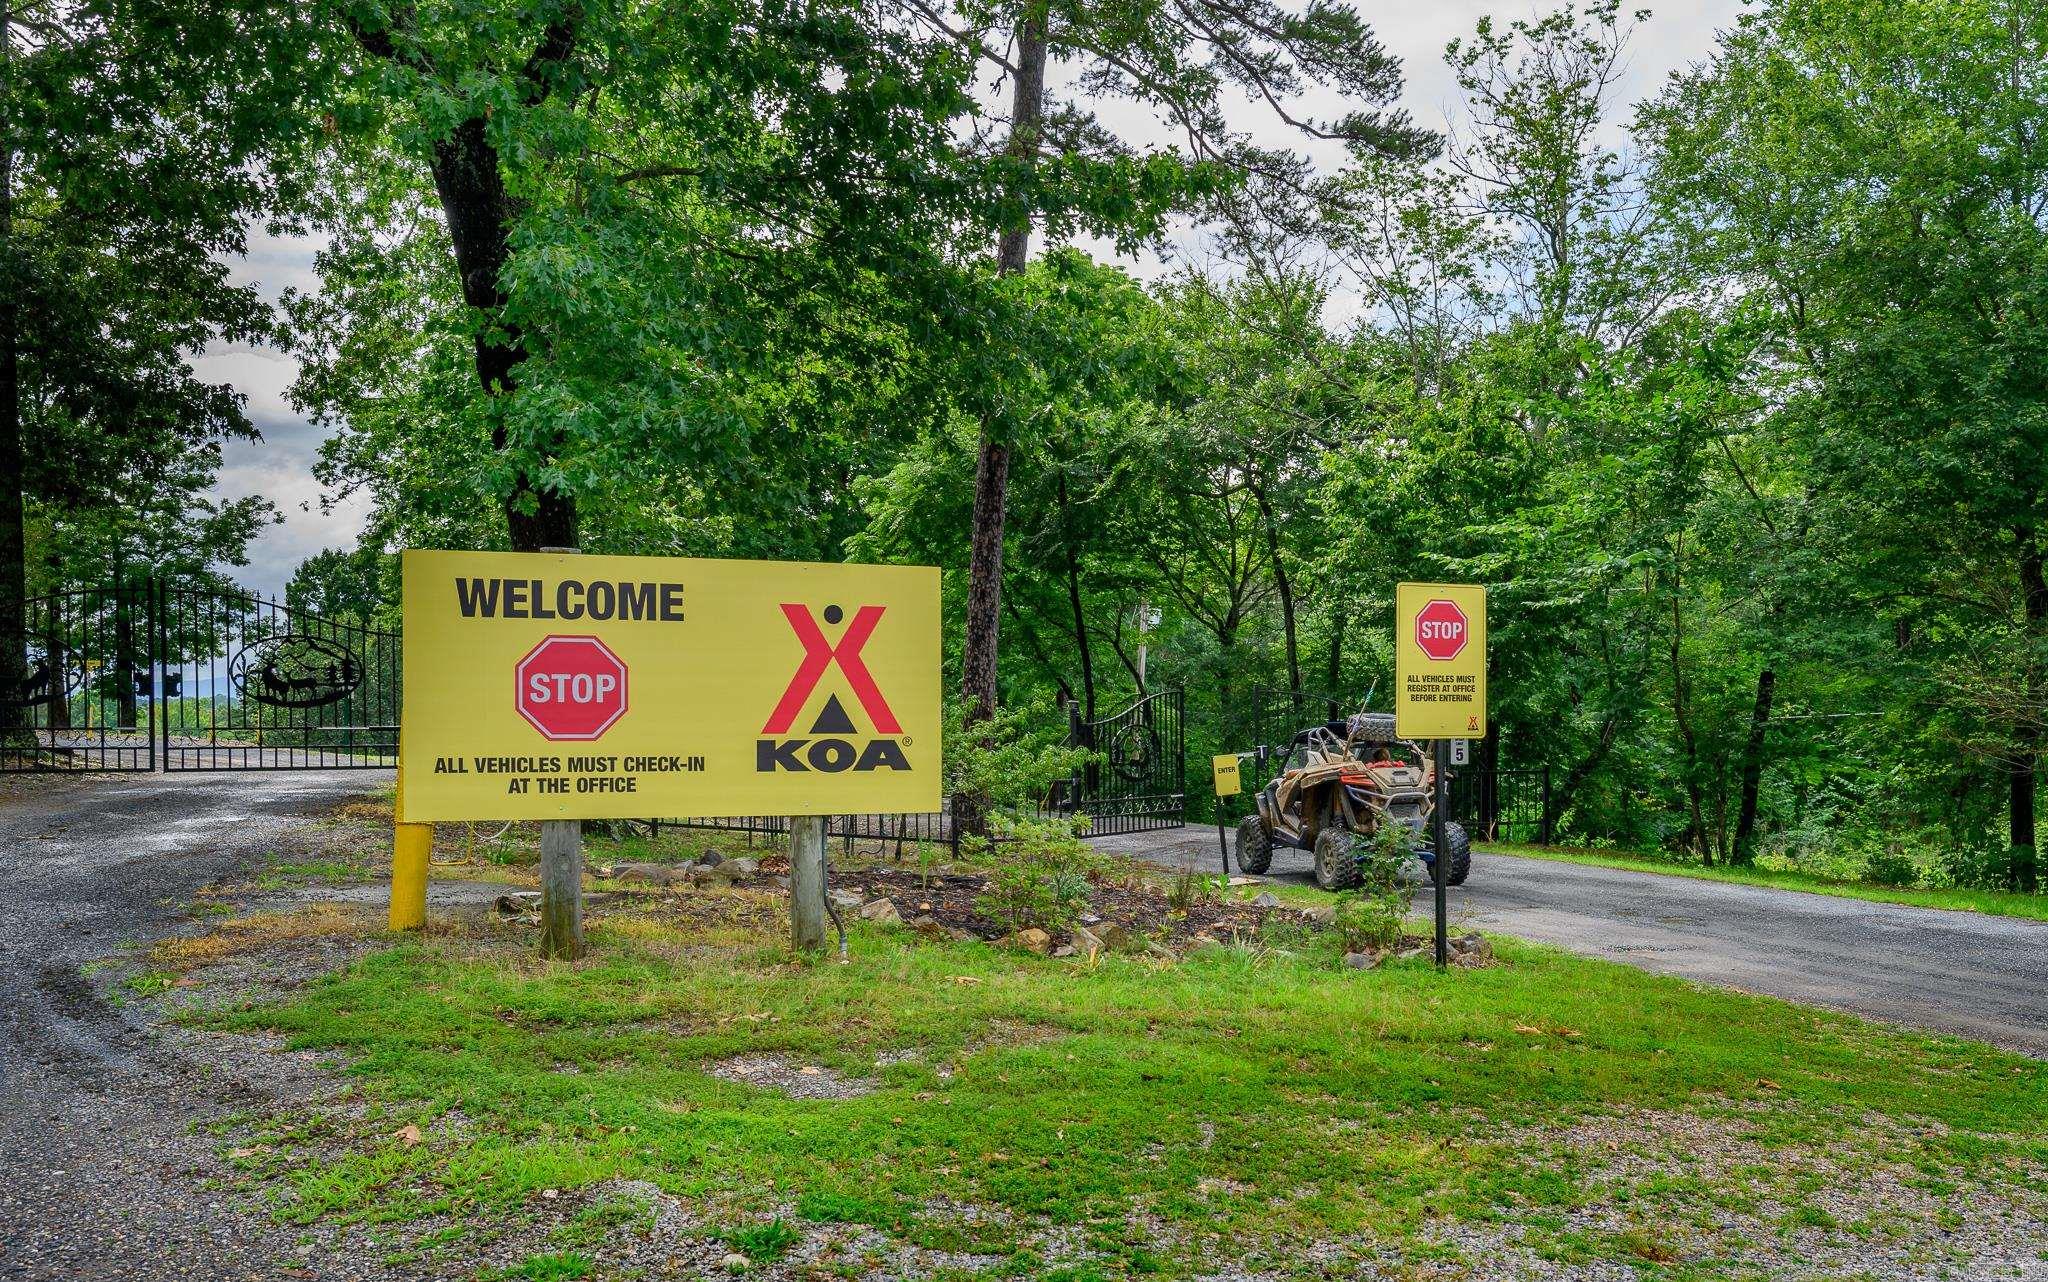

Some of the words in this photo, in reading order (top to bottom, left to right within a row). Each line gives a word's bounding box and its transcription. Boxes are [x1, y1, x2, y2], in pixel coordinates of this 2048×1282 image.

[455, 577, 685, 622] WELCOME
[1421, 621, 1463, 640] STOP
[1407, 675, 1420, 683] ALL
[1422, 675, 1454, 683] VEHICLES
[1456, 675, 1476, 683] MUST
[529, 673, 616, 704] STOP
[1407, 684, 1440, 692] REGISTER
[1442, 684, 1450, 692] AT
[1452, 684, 1476, 692] OFFICE
[1411, 694, 1437, 702] BEFORE
[1439, 694, 1473, 702] ENTERING
[1455, 747, 1464, 761] 5
[434, 757, 468, 774] ALL
[474, 757, 561, 773] VEHICLES
[567, 756, 618, 773] MUST
[623, 756, 705, 772] CHECK-IN
[508, 777, 532, 794] AT
[536, 777, 570, 793] THE
[576, 777, 637, 793] OFFICE
